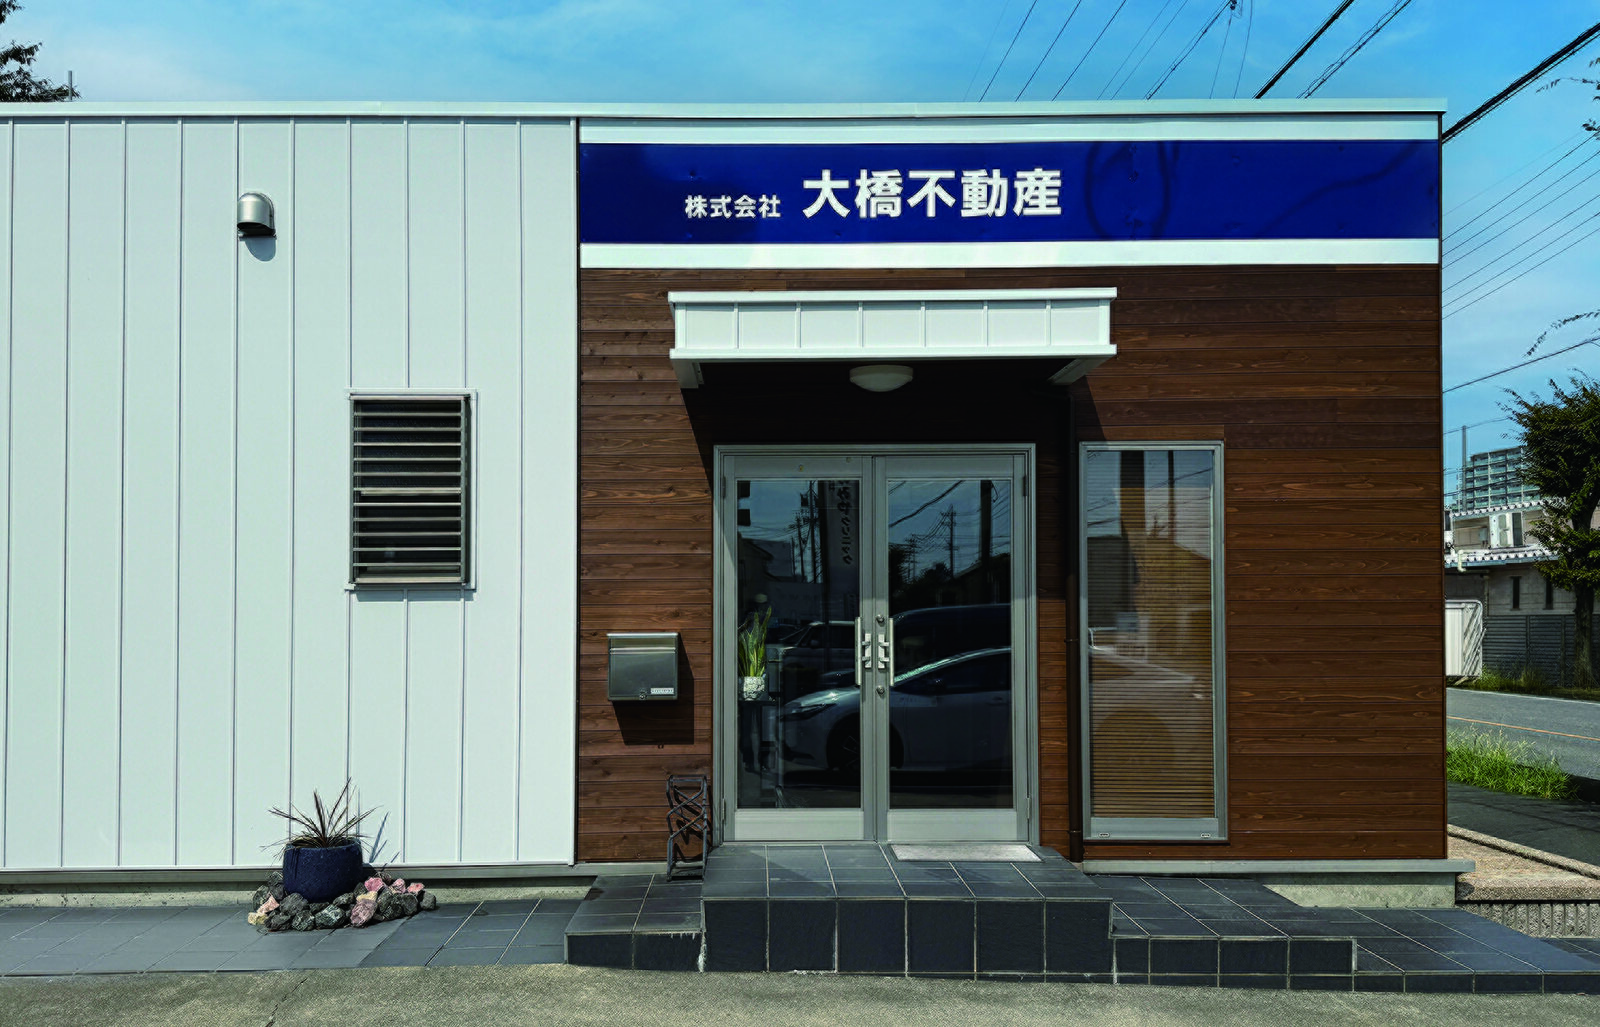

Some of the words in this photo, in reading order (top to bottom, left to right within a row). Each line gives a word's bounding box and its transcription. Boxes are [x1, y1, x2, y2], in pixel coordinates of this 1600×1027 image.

[685, 194, 781, 218] 株式会社
[802, 168, 1062, 218] 大橋不動産
